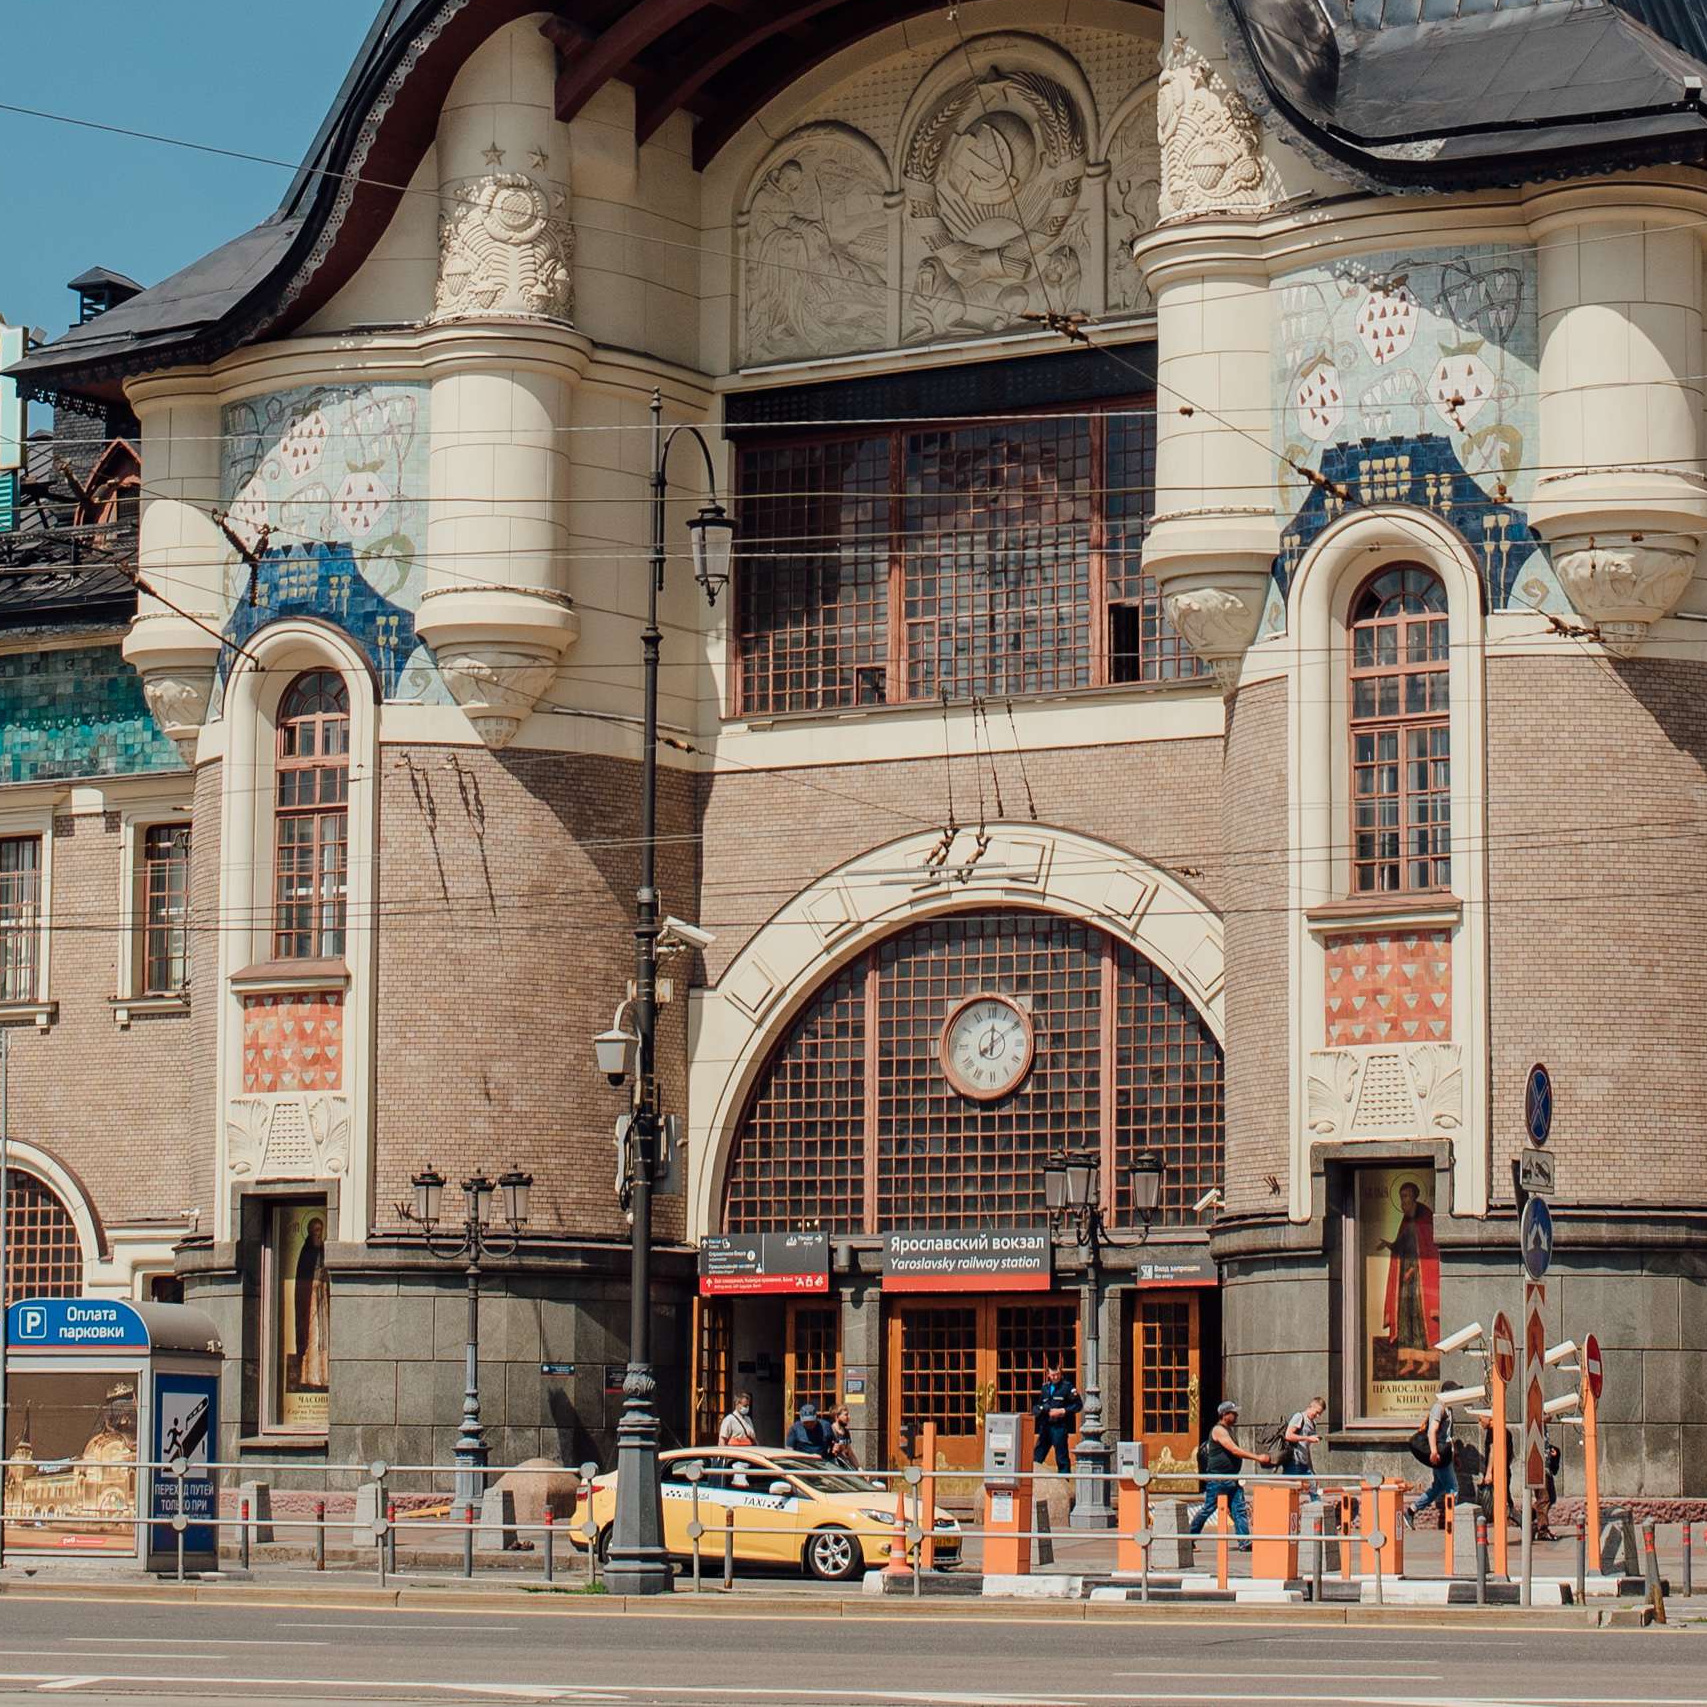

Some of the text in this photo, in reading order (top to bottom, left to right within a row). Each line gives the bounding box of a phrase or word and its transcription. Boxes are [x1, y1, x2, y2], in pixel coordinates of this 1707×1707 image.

[891, 1234, 1045, 1255] Ярославский вокзал
[891, 1256, 1040, 1272] Yaroslavsky railway station
[66, 1306, 117, 1322] Оплата
[26, 1311, 41, 1334] P
[59, 1326, 125, 1341] парковки
[1372, 1383, 1440, 1394] ПРАВОСЛАВН
[1397, 1395, 1429, 1404] КНИГА
[154, 1481, 214, 1496] ПЕРЕХД ПУТЕЙ
[161, 1499, 207, 1511] ТОЛЬО ПРИ
[743, 1496, 766, 1507] TAXI
